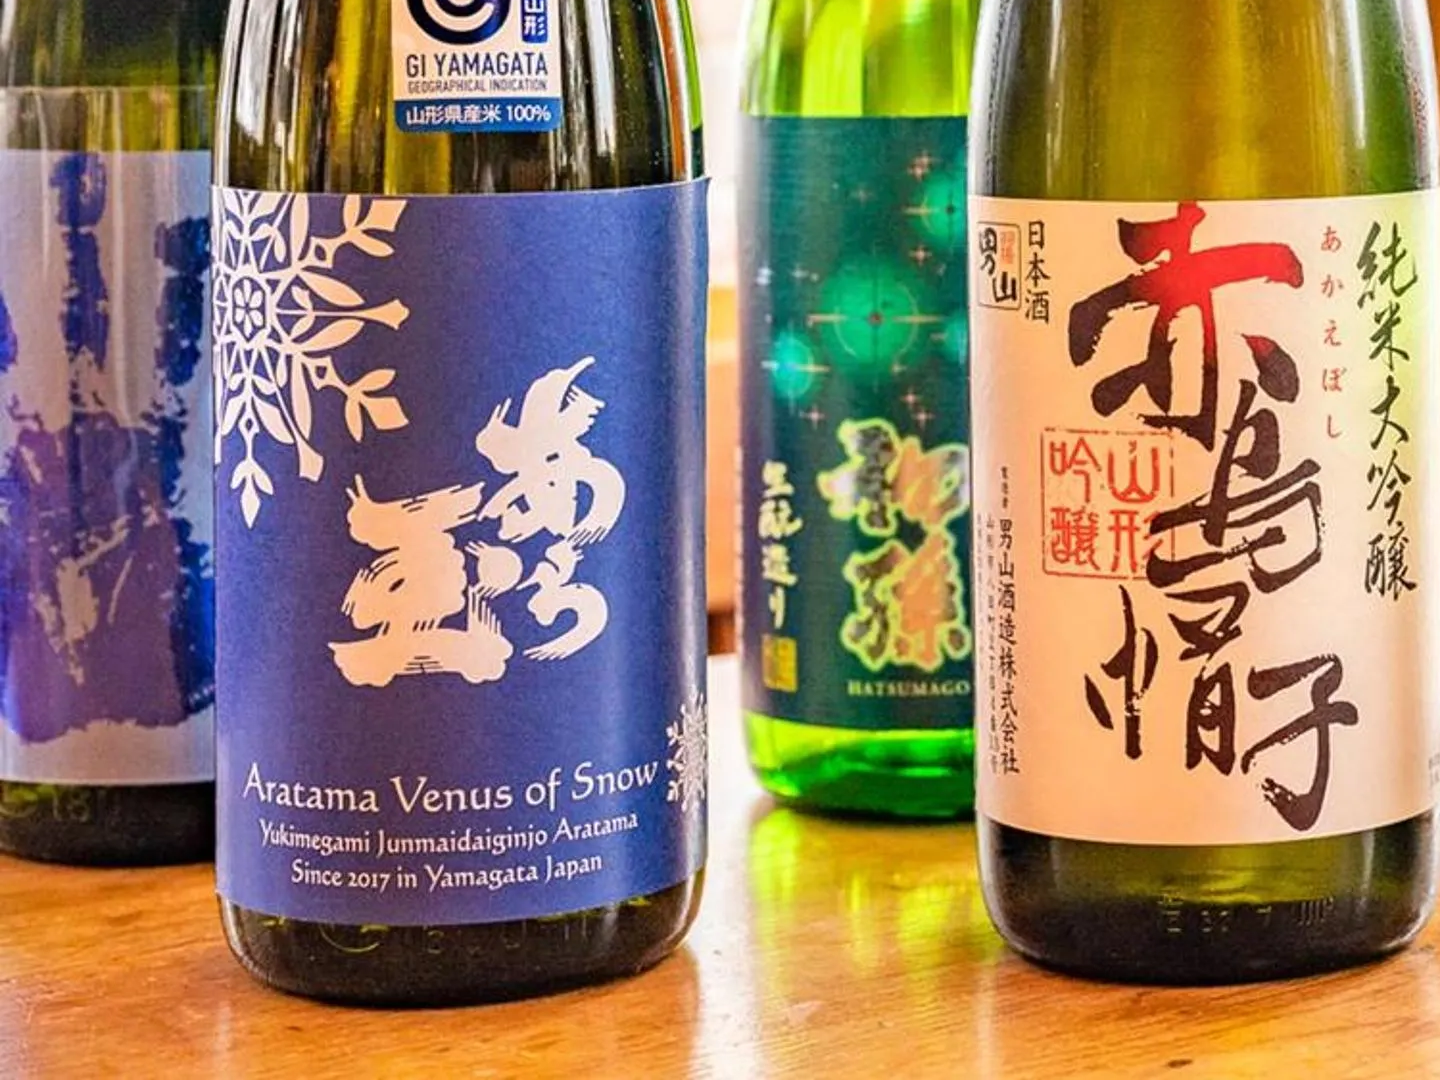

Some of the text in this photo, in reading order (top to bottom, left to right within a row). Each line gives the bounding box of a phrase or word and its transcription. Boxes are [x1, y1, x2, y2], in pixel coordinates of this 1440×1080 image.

[406, 51, 548, 78] GI YAMAGATA
[407, 76, 547, 94] GEOGRAPHICAL INDICATION
[406, 102, 552, 126] 山形県産米 100%
[1024, 219, 1051, 325] 日本酒
[1319, 224, 1344, 441] あかえぼし
[1356, 220, 1419, 602] 純米大吟醸
[998, 518, 1020, 775] 男山酒造株式会社
[847, 679, 970, 698] HATSUMAGO
[243, 760, 659, 815] Aratama Venus of Snow
[258, 810, 640, 857] Yukimegami Junmaidaiginjo Aratama
[290, 855, 603, 892] Since 2017 in Yamagata Japan
